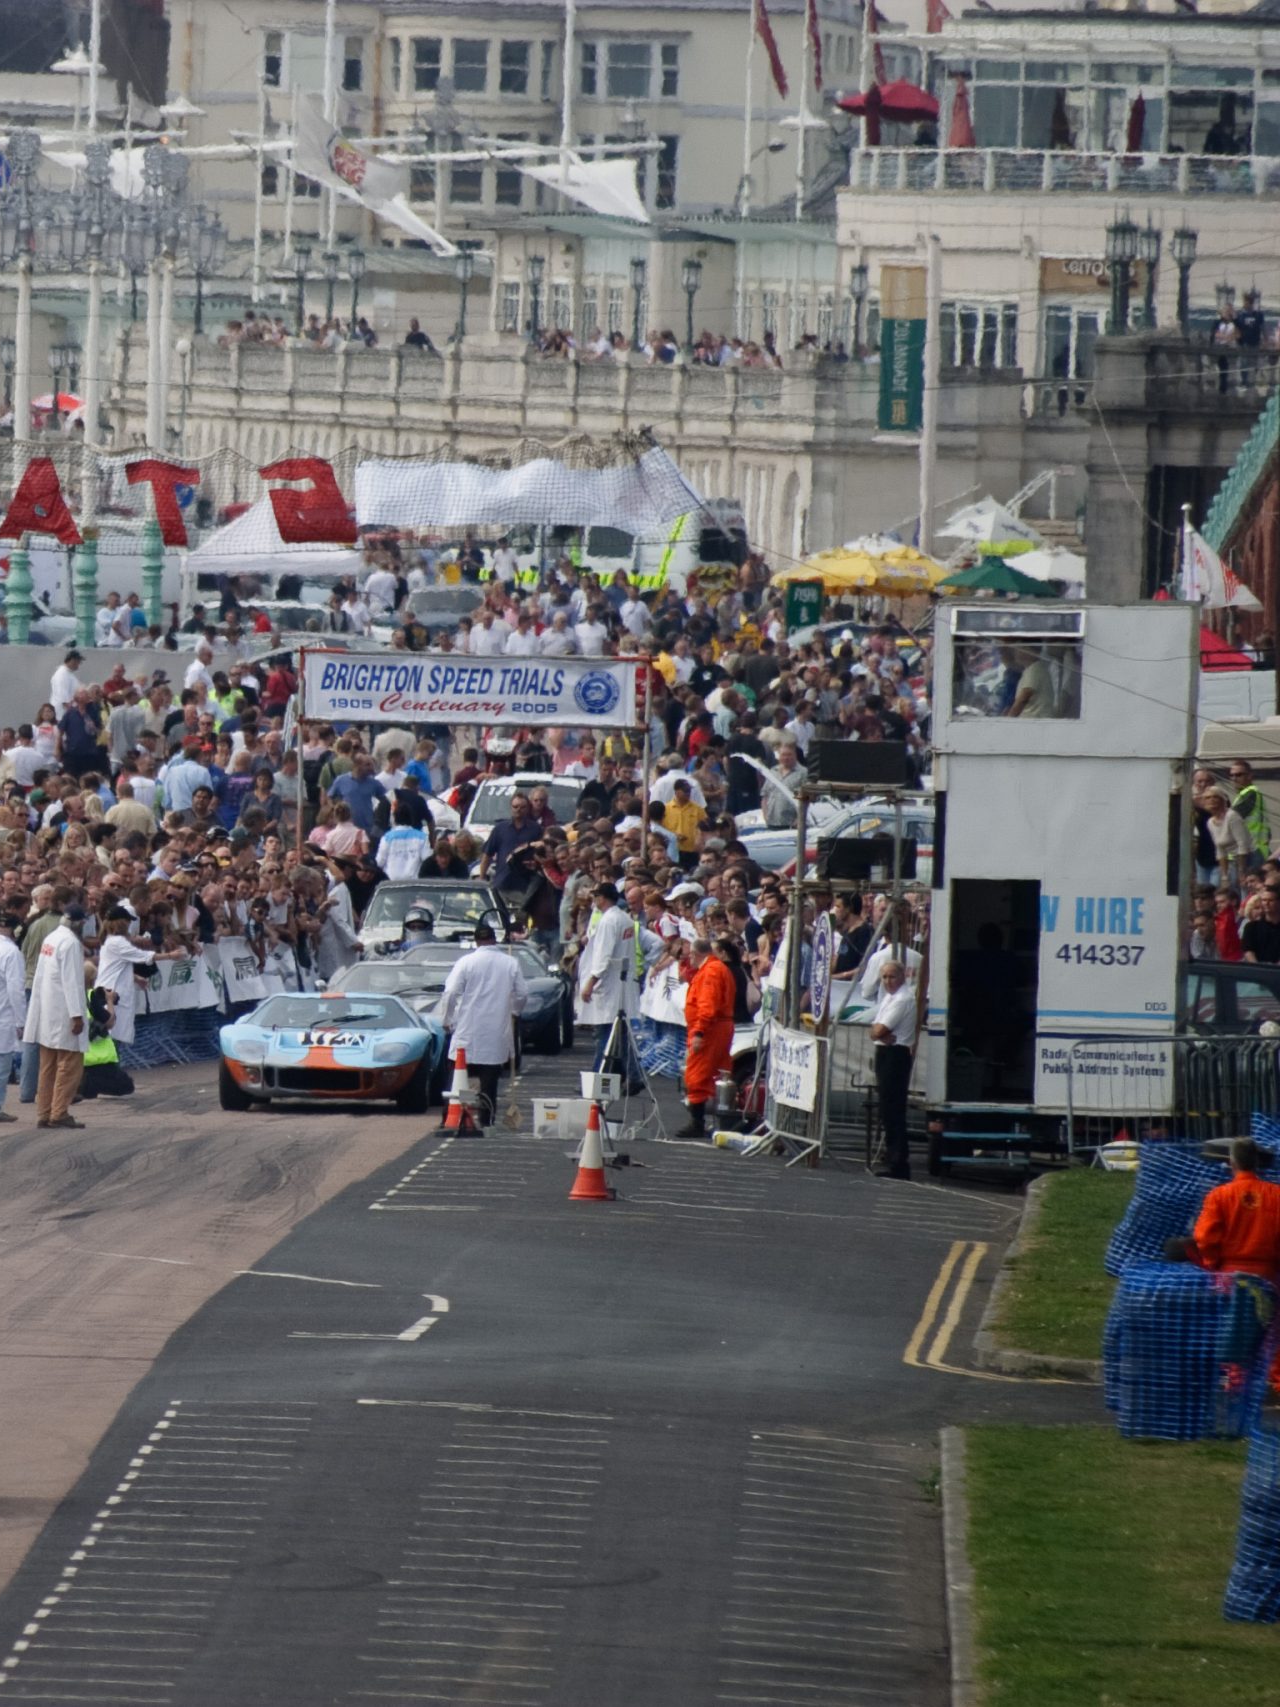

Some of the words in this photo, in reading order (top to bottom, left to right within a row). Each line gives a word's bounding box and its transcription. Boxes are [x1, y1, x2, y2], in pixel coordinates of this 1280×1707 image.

[321, 663, 422, 693] BRIGHTON
[427, 665, 493, 695] SPEED
[500, 668, 565, 697] TRIALS
[329, 697, 373, 710] 1905
[379, 692, 506, 716] Centenary
[511, 702, 557, 714] 2005
[1075, 897, 1144, 935] HIRE
[1056, 943, 1145, 966] 414337
